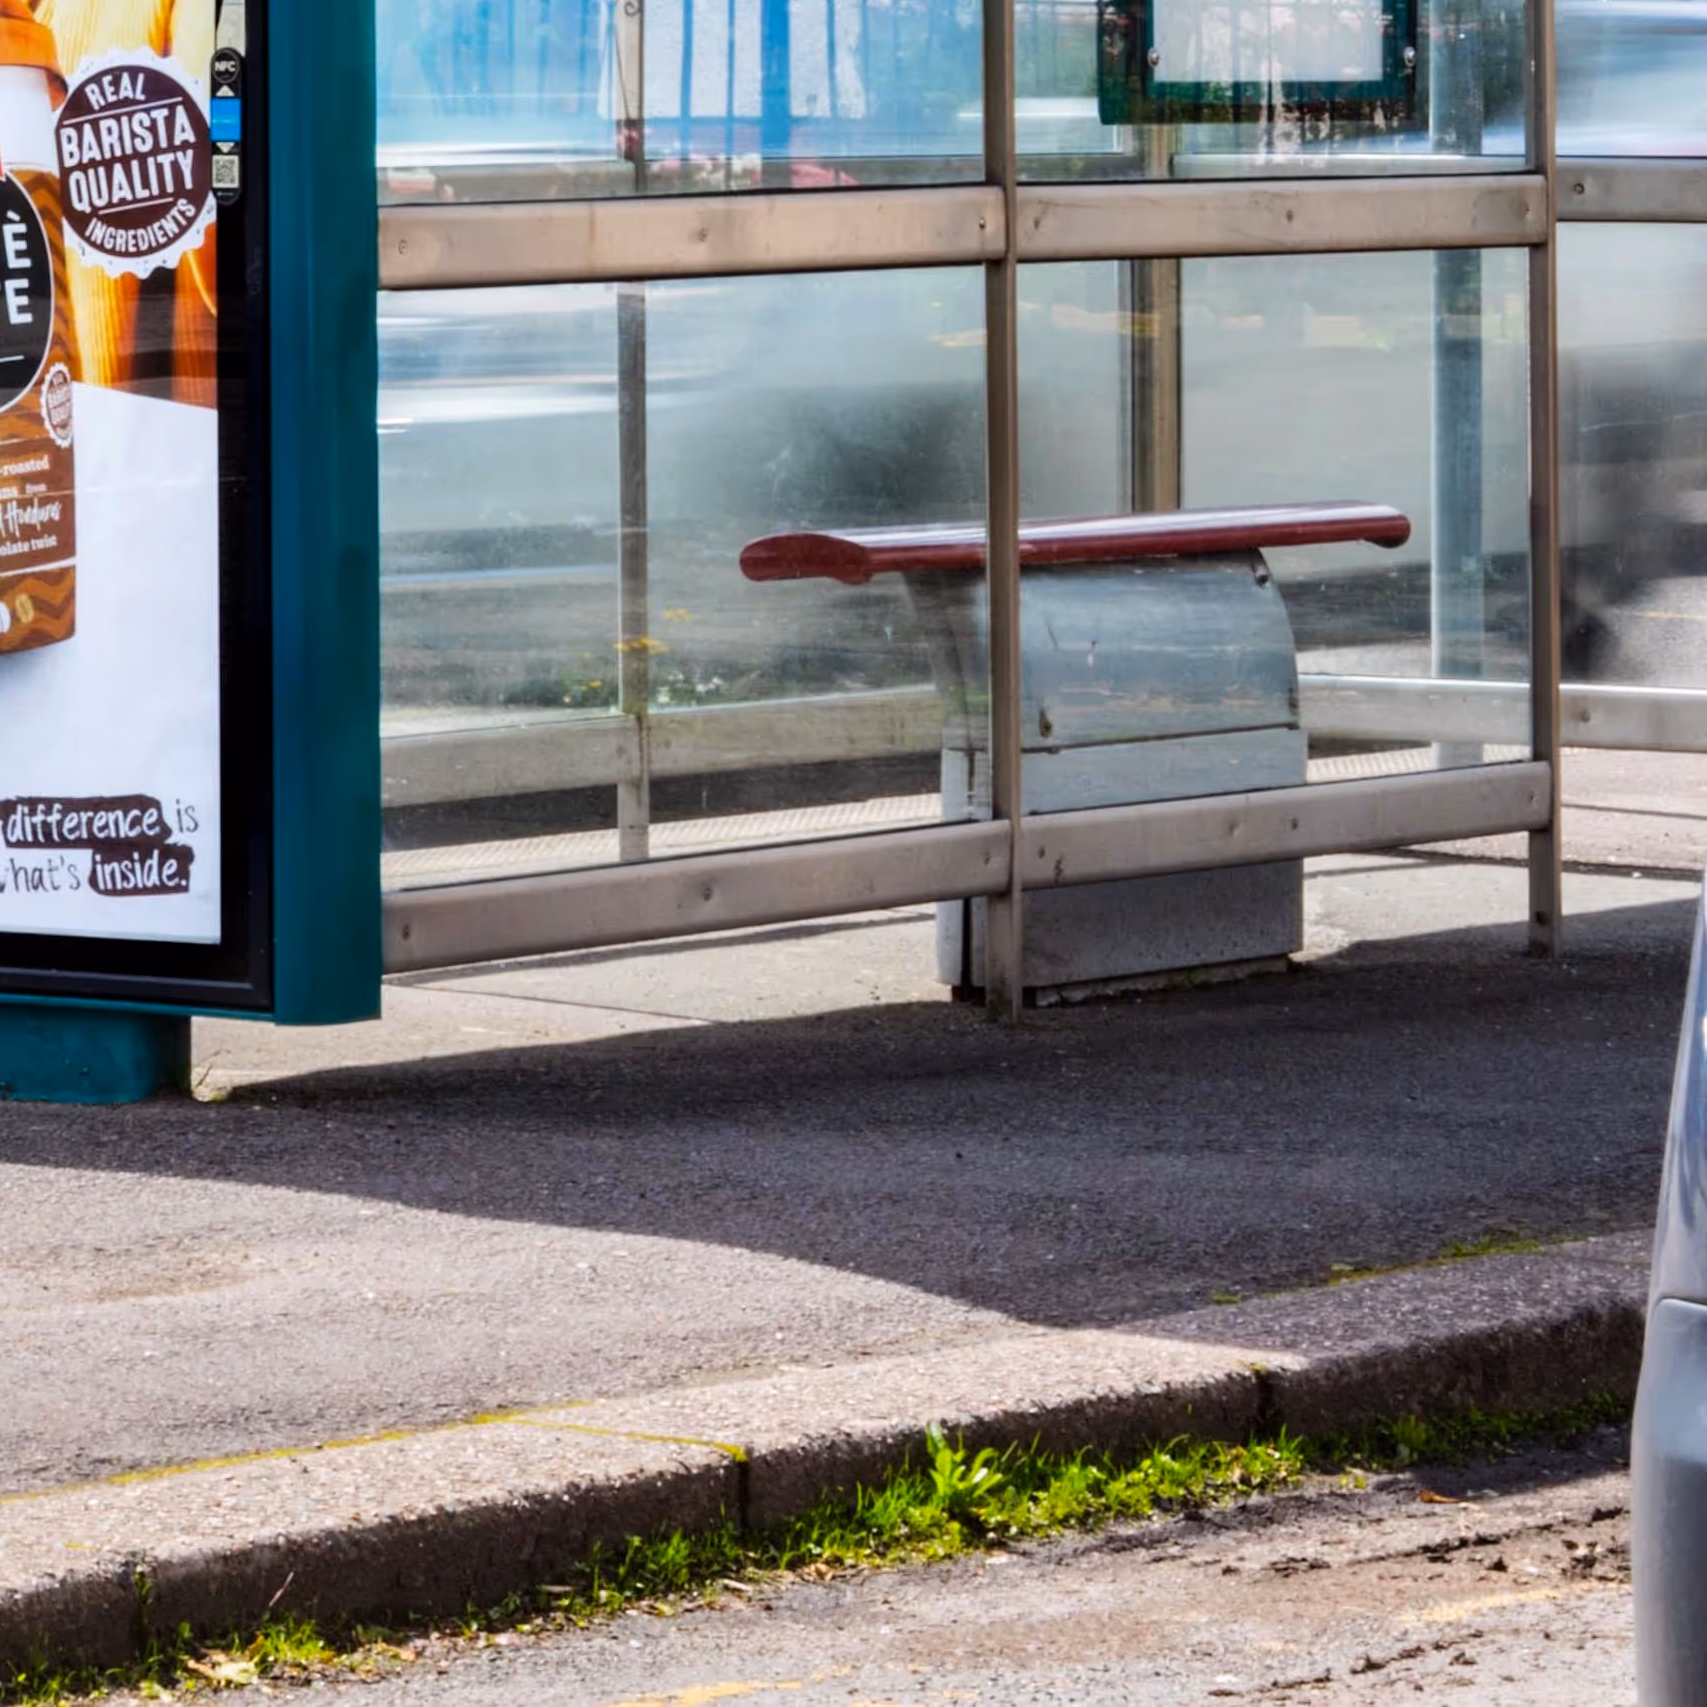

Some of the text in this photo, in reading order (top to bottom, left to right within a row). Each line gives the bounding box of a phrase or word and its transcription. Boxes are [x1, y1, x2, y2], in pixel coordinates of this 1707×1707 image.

[215, 60, 236, 73] NFC
[85, 71, 146, 111] REAL
[60, 105, 196, 168] BARISTA
[68, 149, 195, 214] QUALITY
[85, 197, 197, 252] INGREDIENTS
[6, 802, 161, 844] difference
[176, 799, 199, 835] is
[95, 849, 187, 891] inside.
